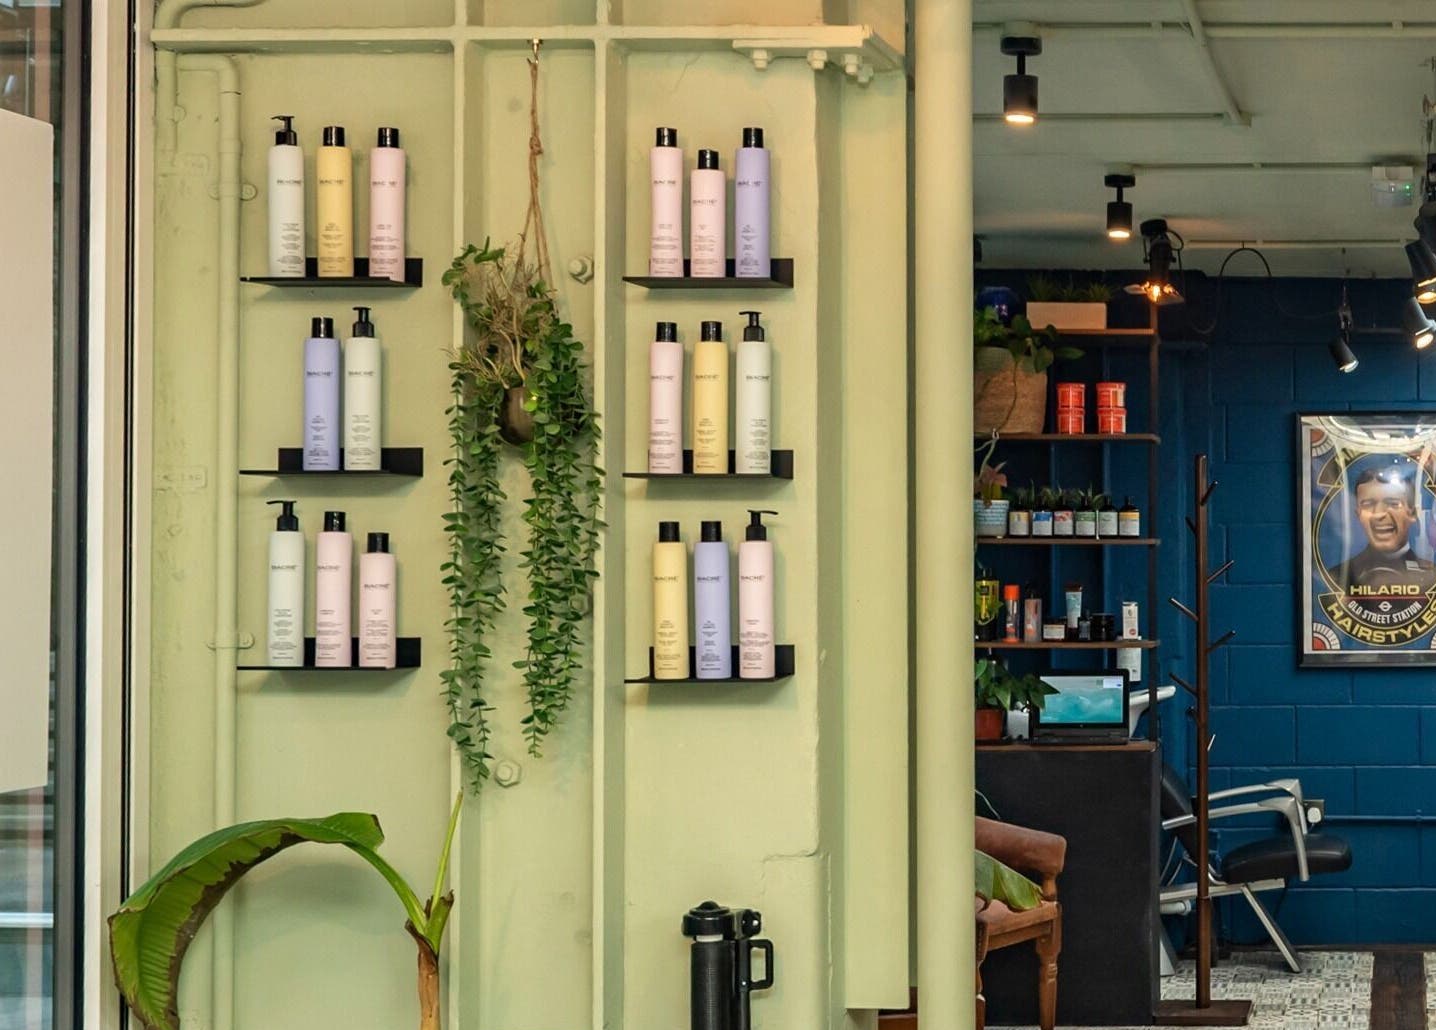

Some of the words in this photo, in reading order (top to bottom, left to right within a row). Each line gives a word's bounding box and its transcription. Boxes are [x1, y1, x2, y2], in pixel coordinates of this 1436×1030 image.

[1350, 585, 1420, 595] HILARIO
[1347, 600, 1362, 614] OLD
[1362, 609, 1391, 624] STREET
[1392, 601, 1422, 623] STATION
